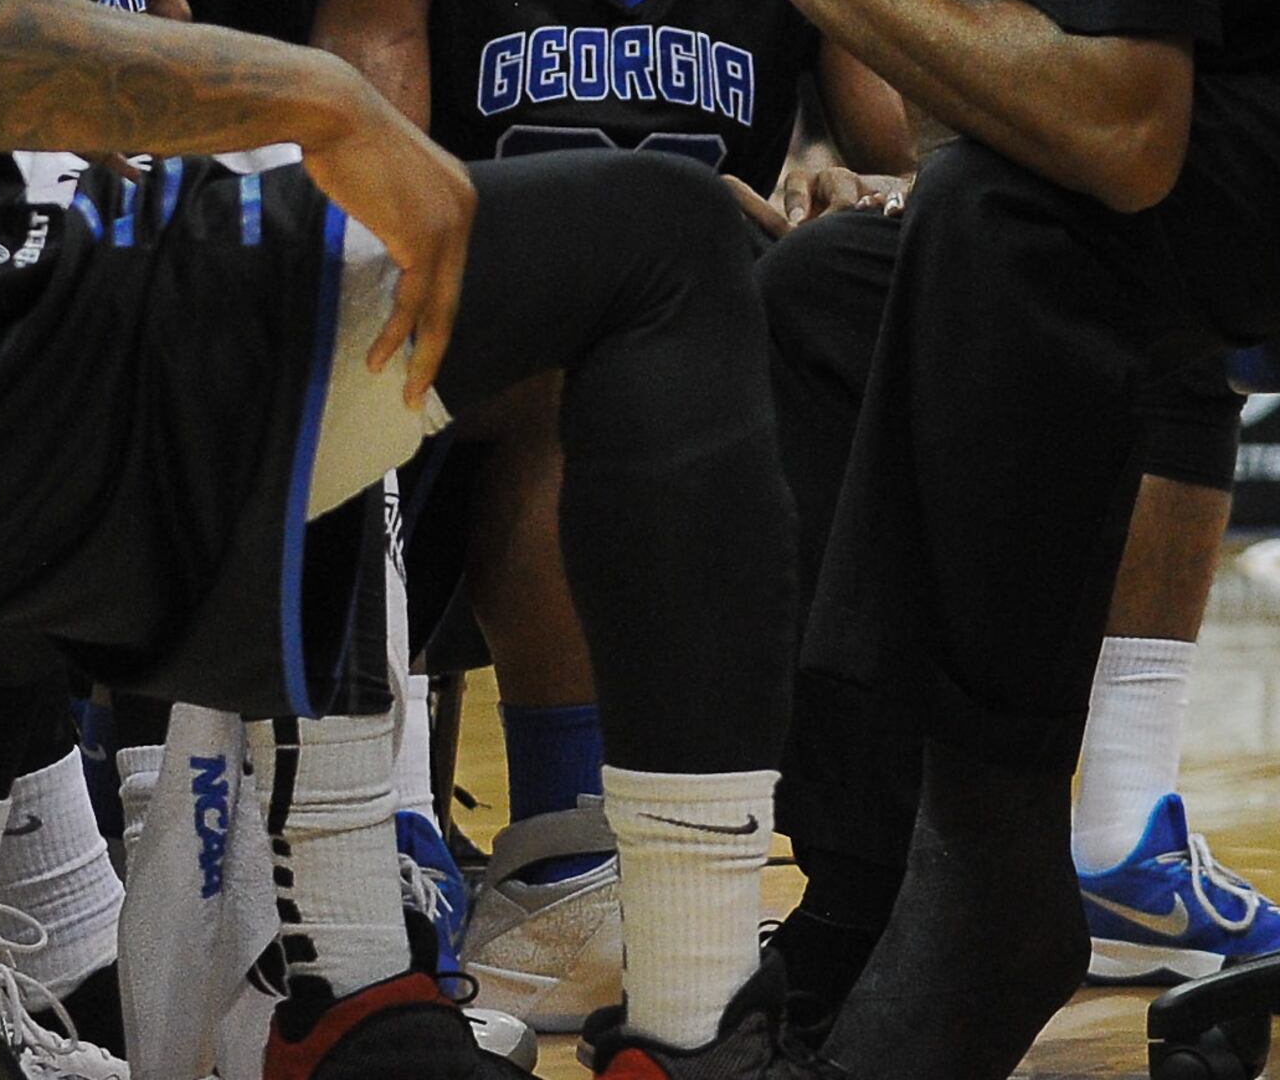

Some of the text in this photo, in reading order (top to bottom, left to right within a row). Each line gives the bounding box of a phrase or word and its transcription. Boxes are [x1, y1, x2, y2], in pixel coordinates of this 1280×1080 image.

[477, 25, 754, 126] GEORGIA
[13, 211, 50, 264] BELT
[189, 754, 228, 899] NCAA
